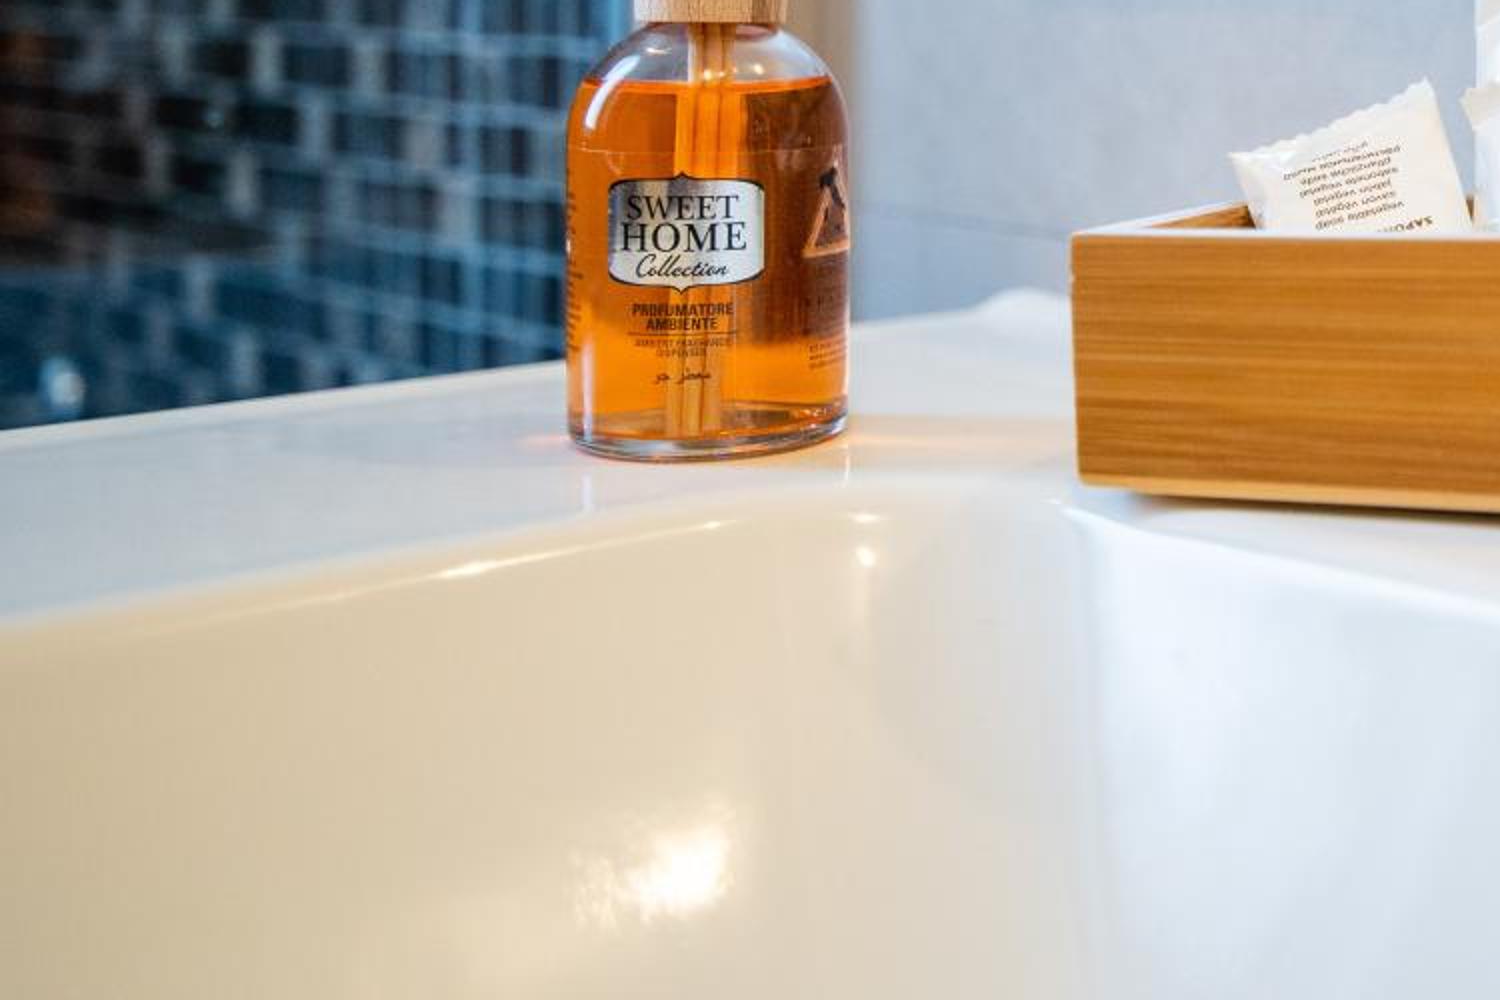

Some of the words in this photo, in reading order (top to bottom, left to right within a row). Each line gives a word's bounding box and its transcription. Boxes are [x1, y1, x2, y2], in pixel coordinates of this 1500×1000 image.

[626, 195, 739, 221] SWEET
[620, 221, 748, 252] HOME
[635, 253, 728, 278] Collection
[632, 302, 735, 317] PROFUMATORE
[646, 317, 718, 331] AMBIENTE
